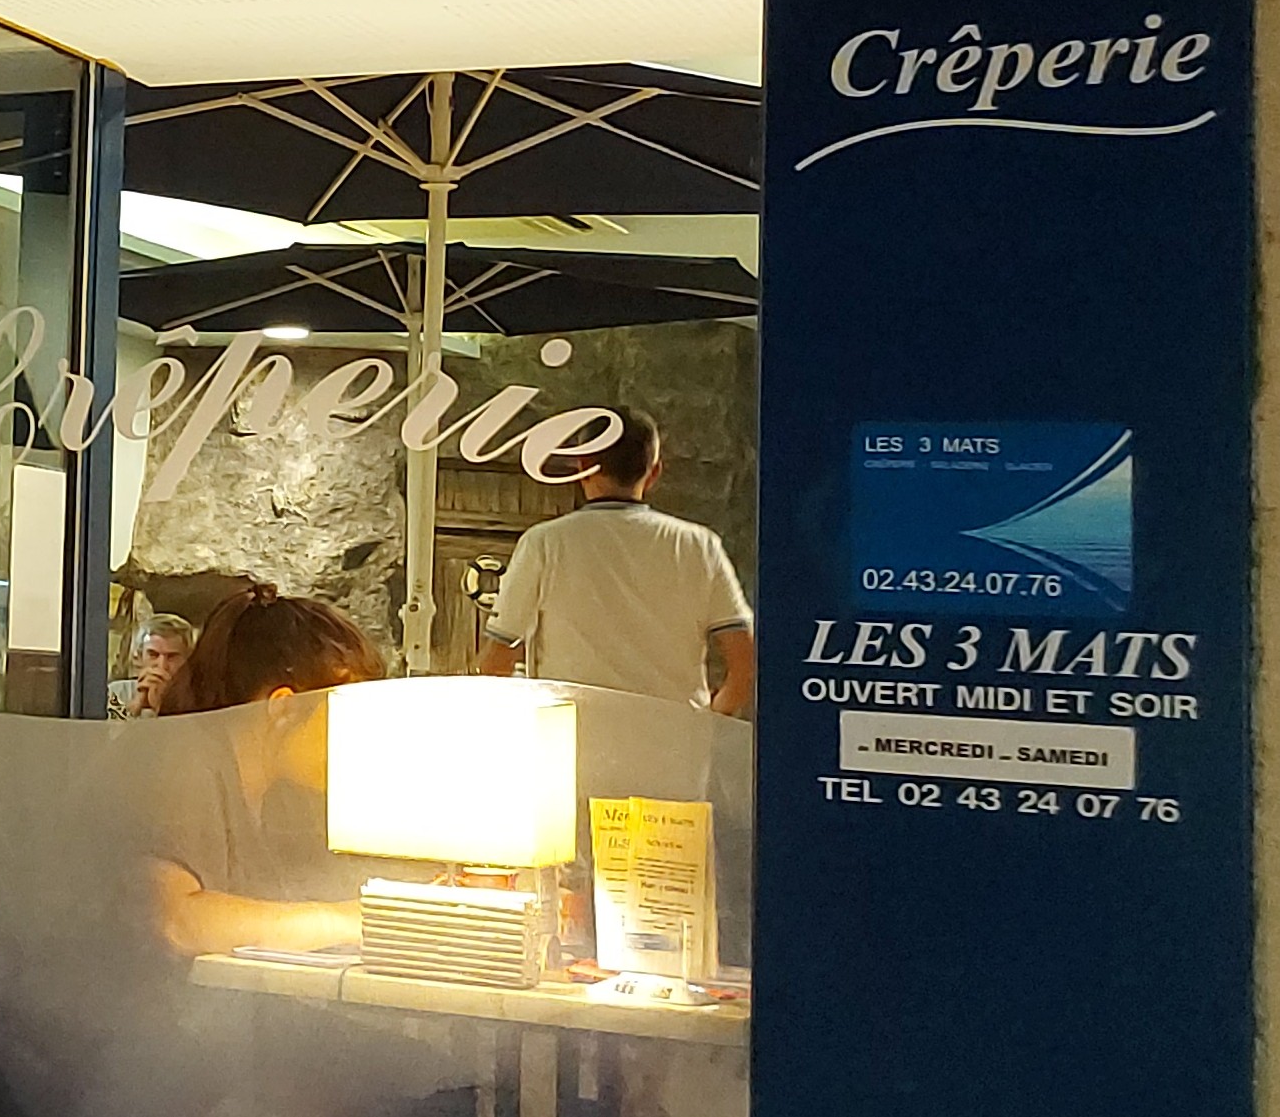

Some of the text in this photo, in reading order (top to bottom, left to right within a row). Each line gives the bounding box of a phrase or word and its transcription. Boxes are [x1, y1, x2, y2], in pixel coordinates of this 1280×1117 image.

[830, 14, 1211, 111] Crêperie
[865, 436, 1001, 454] LES 3 MATS
[863, 568, 1062, 597] 02.43.24.07.76
[802, 620, 1197, 681] LES 3 MATS
[802, 677, 1198, 720] OUVERT MIDI ET SOIR
[874, 737, 994, 760] MERCREDI
[1016, 747, 1108, 766] SAMEDI
[817, 776, 1181, 823] TEL 02 43 24 07 76
